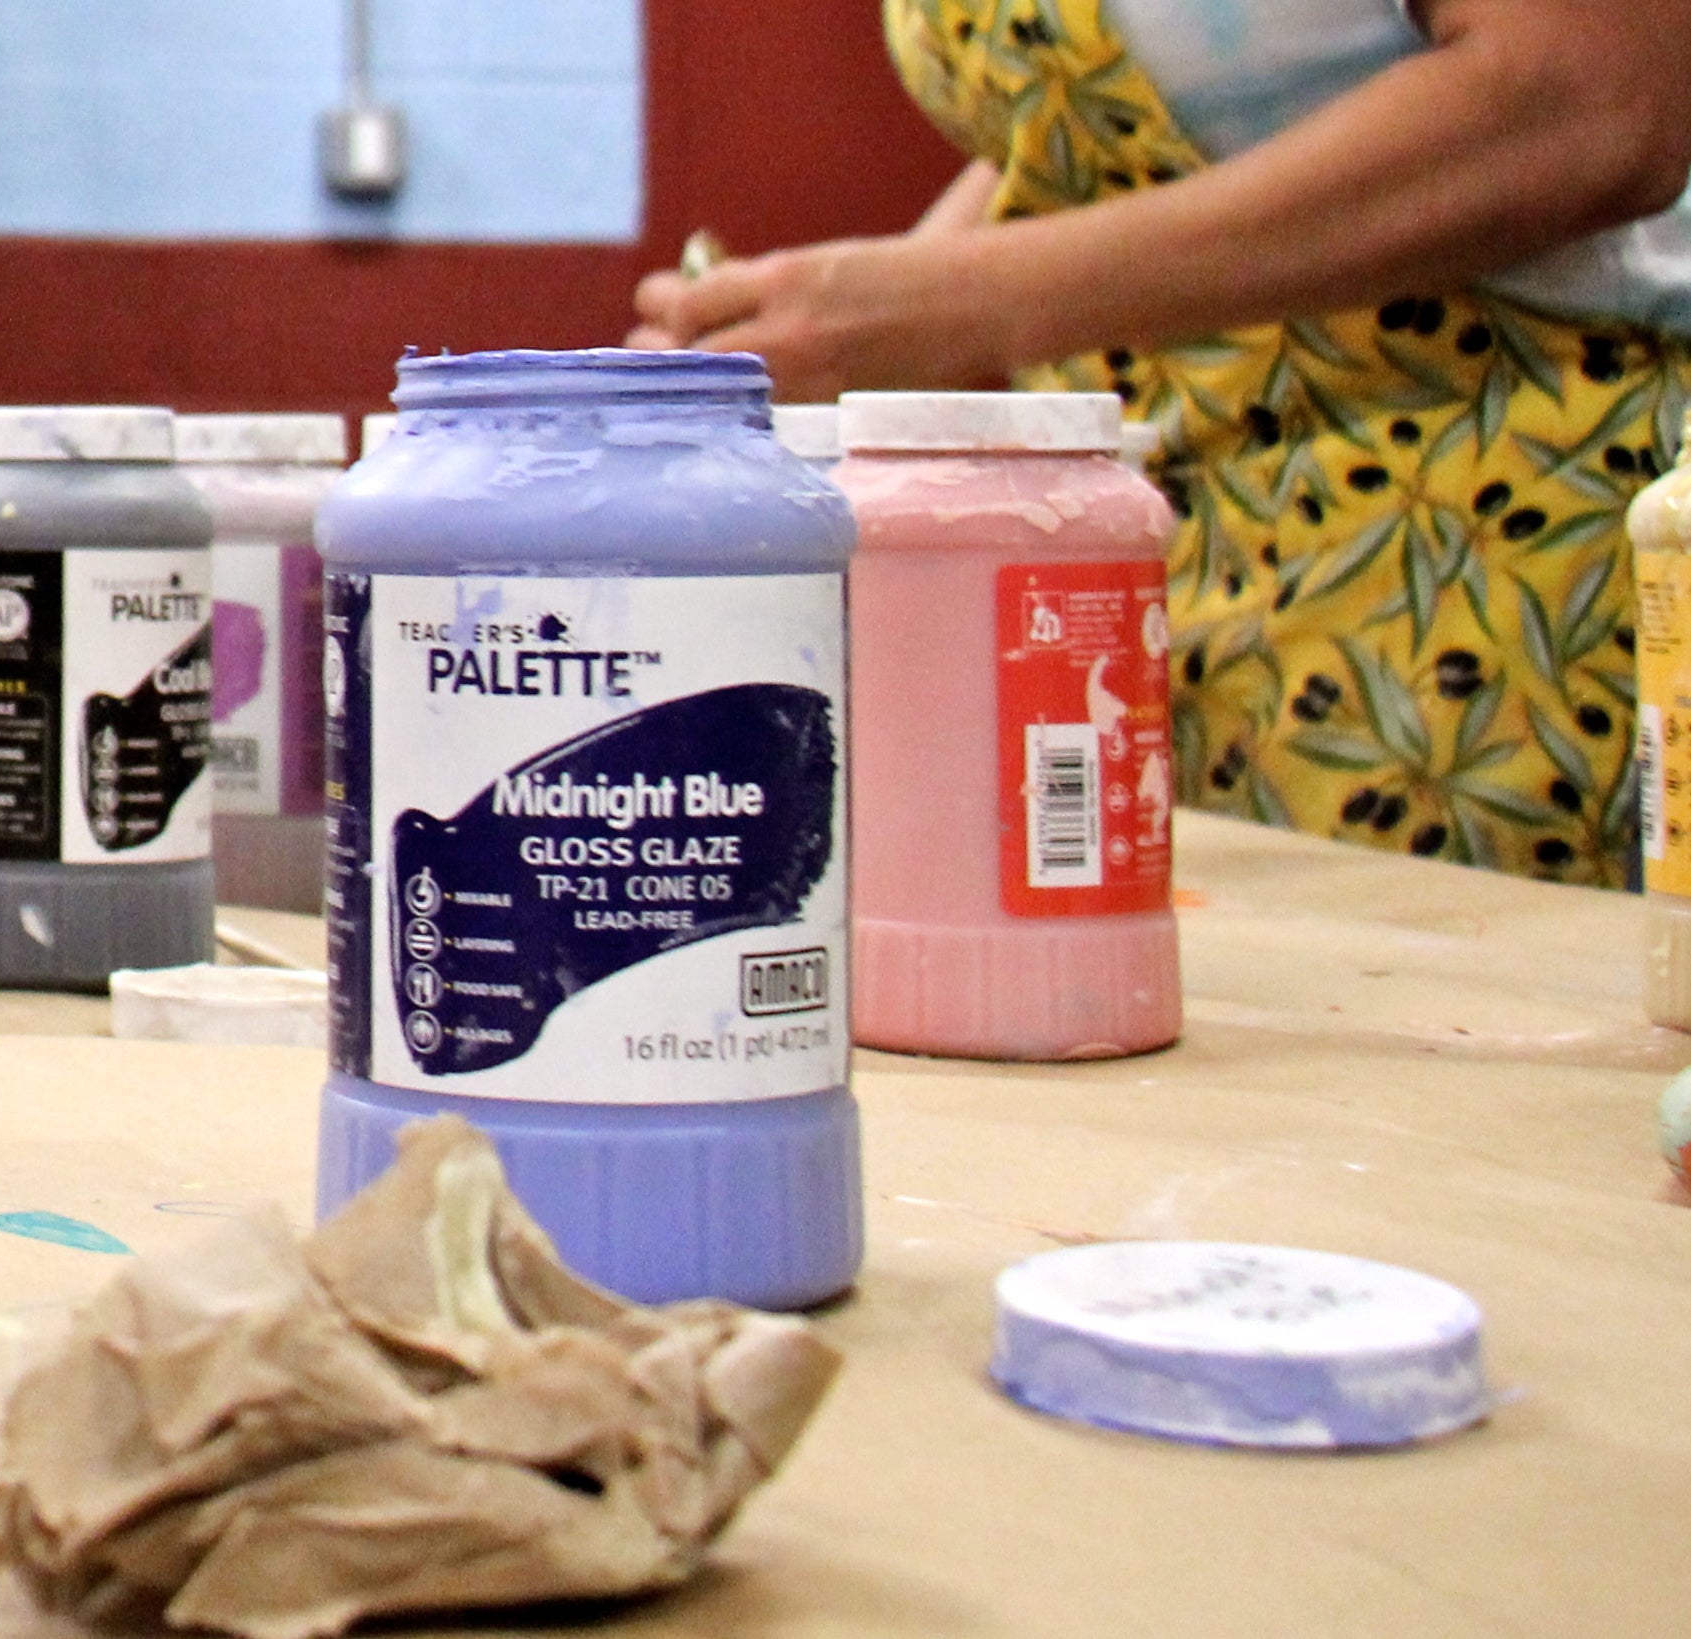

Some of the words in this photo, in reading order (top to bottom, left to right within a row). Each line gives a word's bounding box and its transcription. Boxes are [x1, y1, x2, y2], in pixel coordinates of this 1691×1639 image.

[398, 621, 525, 644] TEACER'S
[428, 648, 632, 696] PALETTE
[492, 772, 678, 830] Midnight
[683, 771, 765, 817] Blue
[519, 835, 635, 867] GLOSS
[639, 835, 743, 866] GLAZE
[535, 873, 609, 902] TP-21
[624, 873, 697, 902] CONE
[699, 873, 733, 901] 05
[573, 910, 696, 931] LEAD-FREE
[624, 1034, 654, 1060] 16
[660, 1033, 678, 1060] fl
[684, 1040, 713, 1060] oz
[719, 1031, 737, 1061] (1
